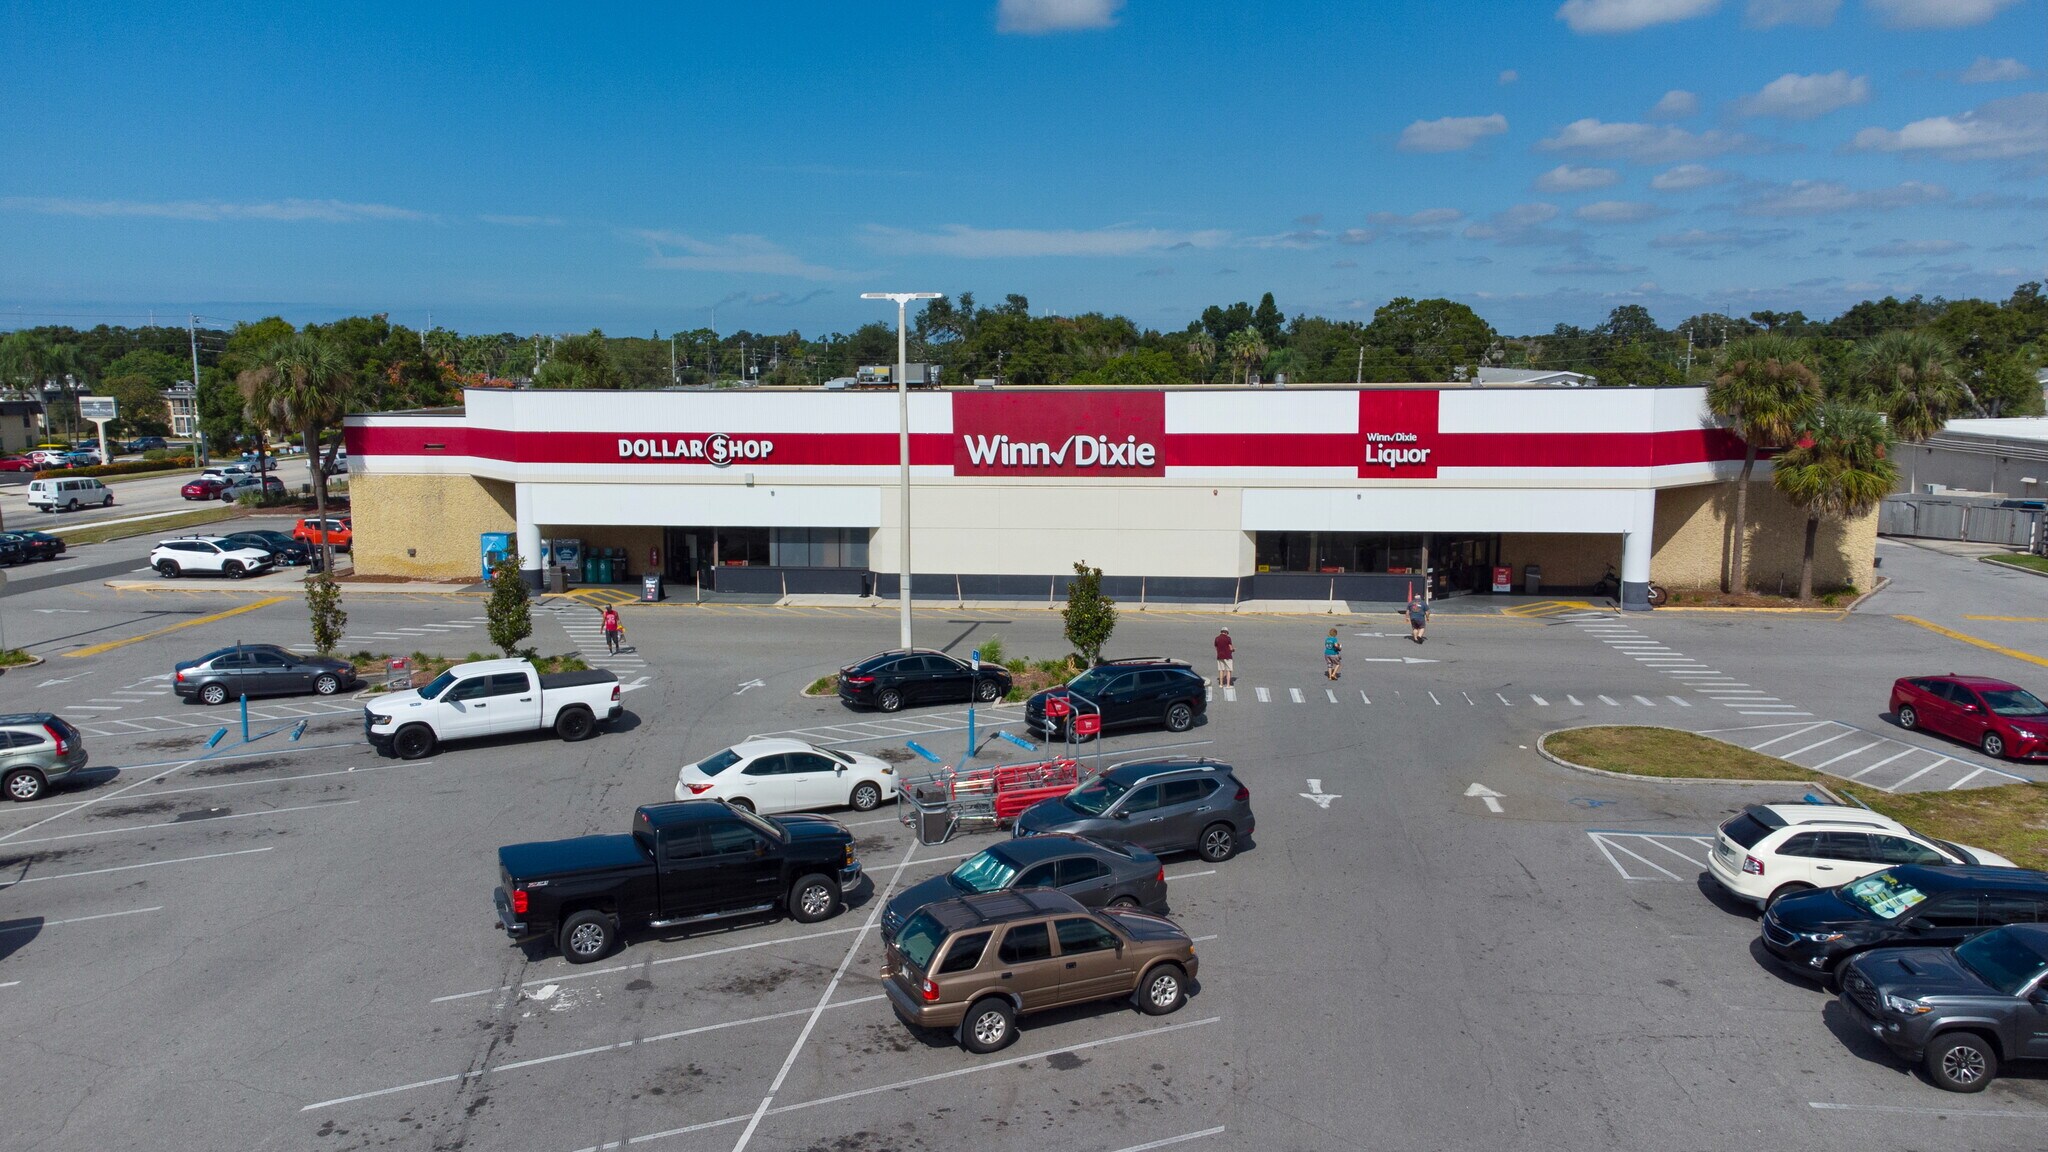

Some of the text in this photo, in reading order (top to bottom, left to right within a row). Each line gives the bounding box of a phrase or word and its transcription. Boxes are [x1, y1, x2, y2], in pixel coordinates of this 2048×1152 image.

[1366, 432, 1418, 442] Winn Dixie
[618, 439, 704, 458] DOLLAR
[963, 434, 1156, 466] Winn Dixie
[1365, 443, 1431, 468] Liquor
